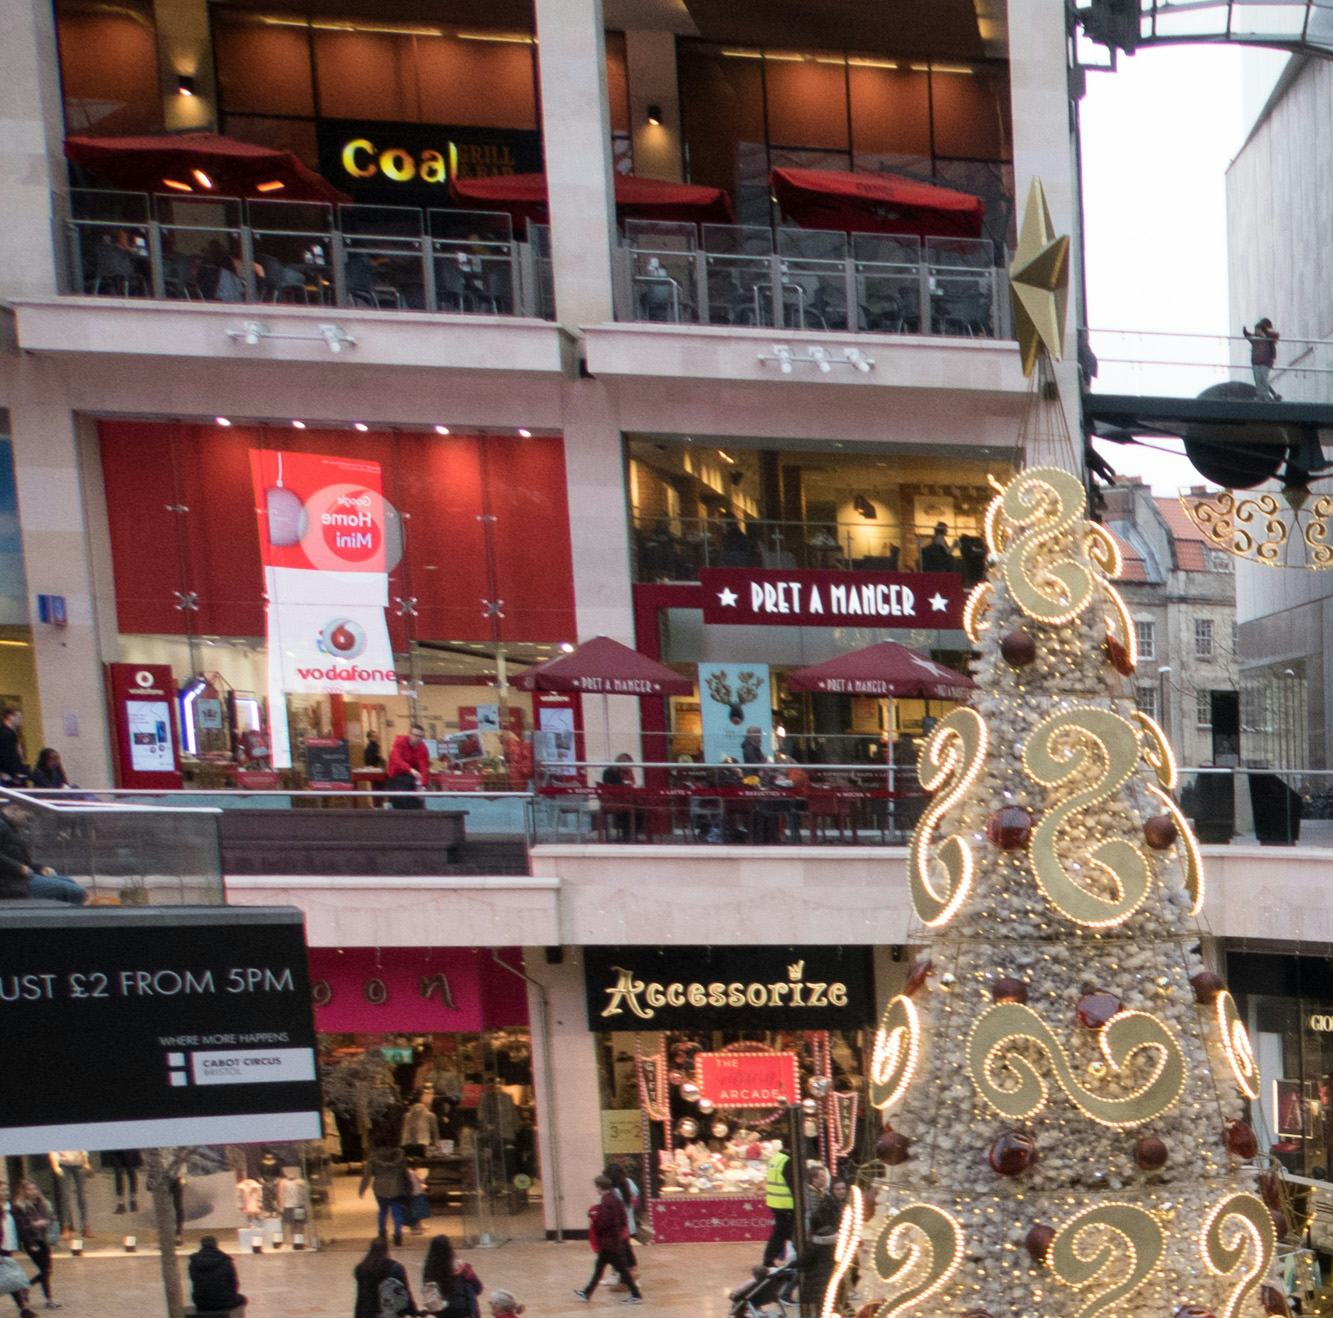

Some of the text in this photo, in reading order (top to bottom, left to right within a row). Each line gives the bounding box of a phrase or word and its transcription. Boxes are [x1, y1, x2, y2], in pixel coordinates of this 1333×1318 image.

[342, 138, 459, 183] Coal
[750, 581, 916, 617] PRET A MANGER
[297, 665, 398, 682] vodafone
[0, 968, 295, 1001] UST £2 FROM 5PM
[601, 960, 849, 1019] Accessorize
[158, 1032, 289, 1046] WHERE MORE HAPPENS
[202, 1056, 282, 1068] CABOT CIRCUS
[715, 1058, 739, 1068] THE
[203, 1066, 243, 1076] BRISTOL
[719, 1088, 780, 1100] ARCADE
